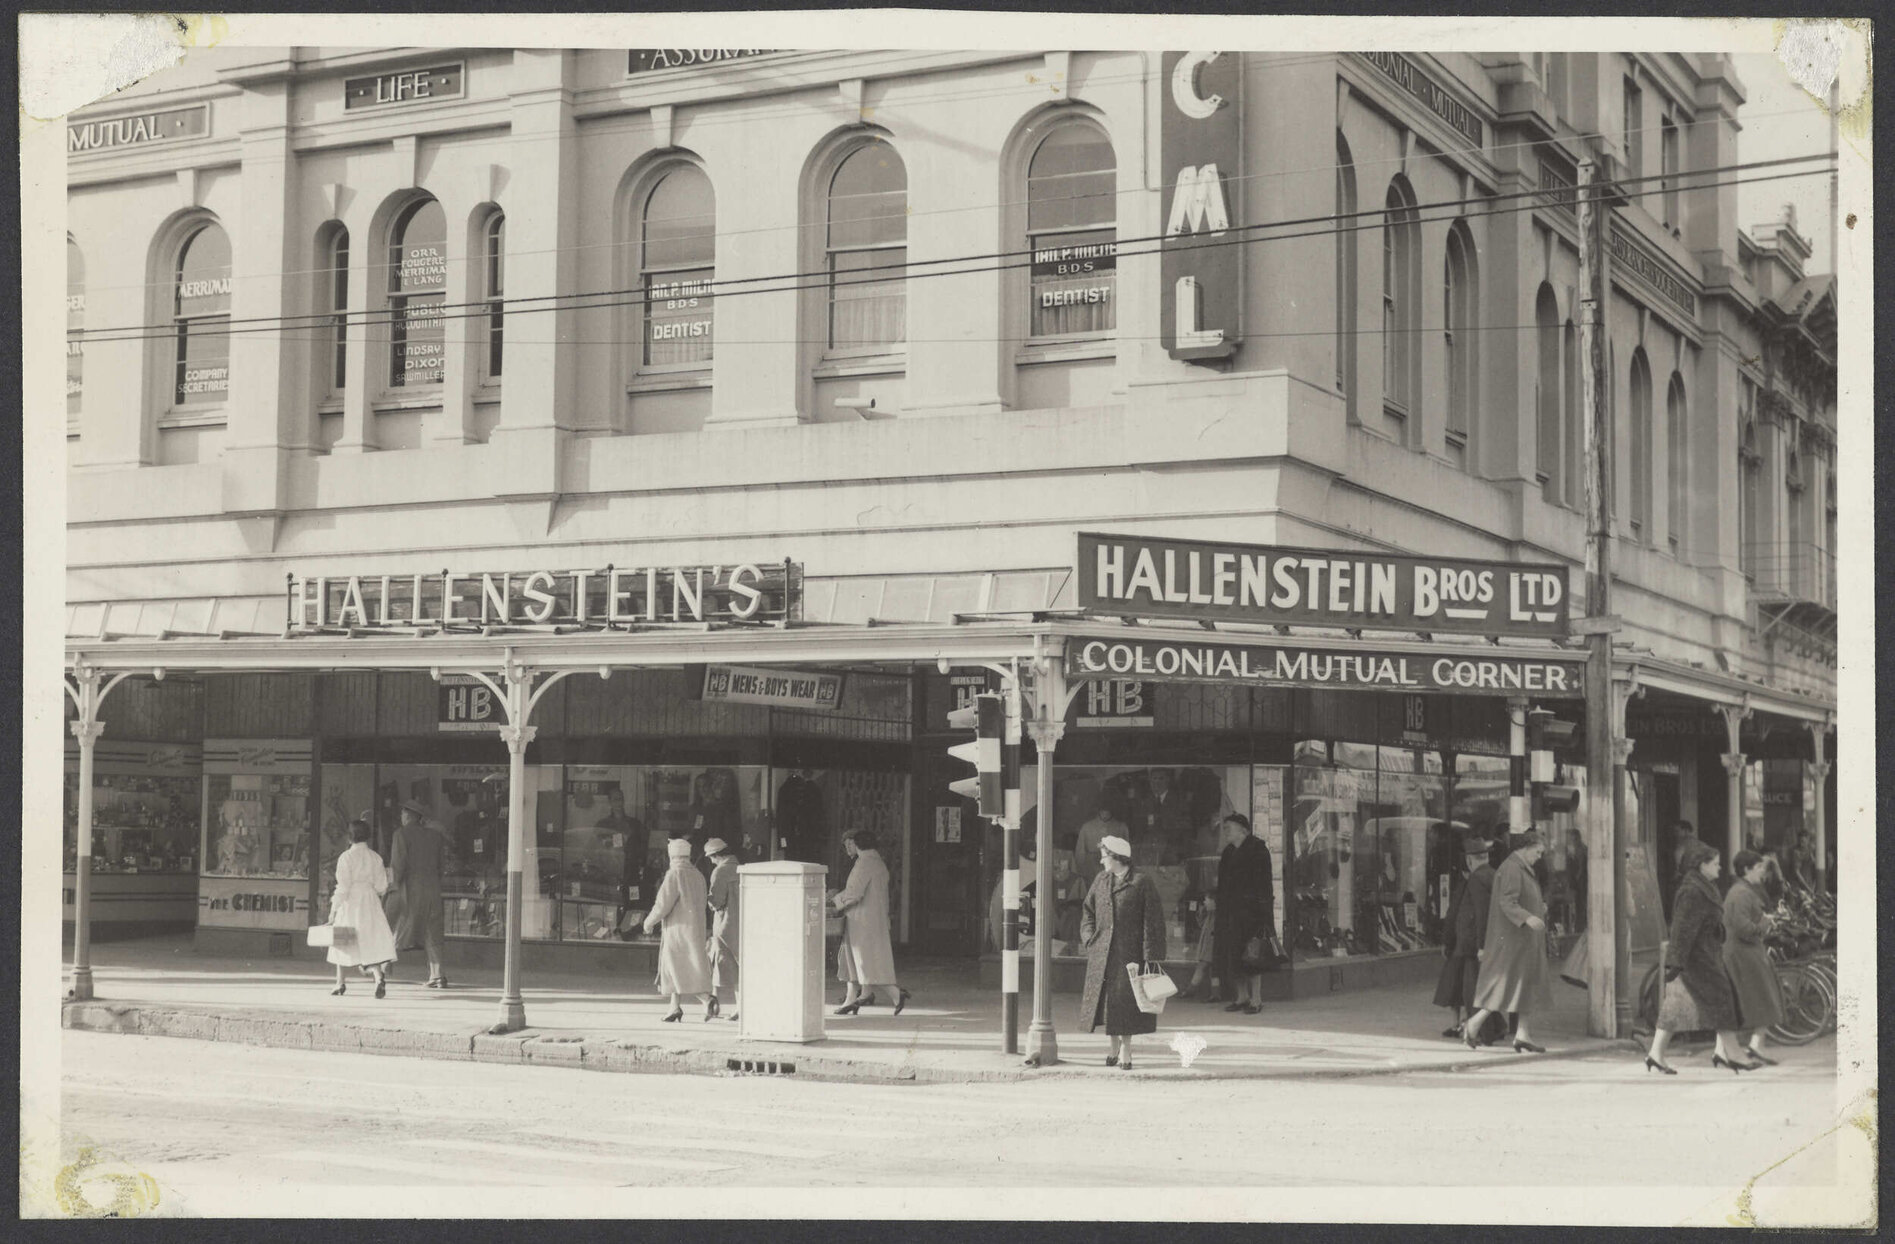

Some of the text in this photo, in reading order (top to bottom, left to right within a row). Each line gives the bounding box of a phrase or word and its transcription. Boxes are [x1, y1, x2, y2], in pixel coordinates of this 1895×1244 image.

[376, 72, 430, 103] LIFE
[1430, 83, 1472, 138] MUTUAL
[68, 115, 163, 151] MUTUAL
[411, 248, 438, 258] ORR
[394, 265, 447, 279] MERRIMA
[413, 275, 442, 286] LANG
[179, 278, 232, 298] MERRIMA
[682, 279, 716, 296] MILN
[1042, 286, 1110, 307] DENTIST
[653, 321, 712, 340] DENTIST
[397, 344, 441, 357] LINDSAY
[185, 368, 228, 381] COMPANY
[396, 370, 445, 383] SAWMILLER
[1097, 544, 1562, 622] HALLENSTEIN BROS LTD
[299, 564, 764, 628] HALLENSTEIN'S
[1083, 641, 1259, 679] COLONIAL
[1276, 650, 1418, 686] MUTUAL
[731, 674, 758, 694] MENS
[765, 677, 789, 697] BOYS
[790, 679, 817, 699] WEAR
[448, 686, 491, 721] HB
[1088, 680, 1143, 715] HB
[1406, 695, 1424, 731] HB
[232, 893, 296, 913] CHEMIST
